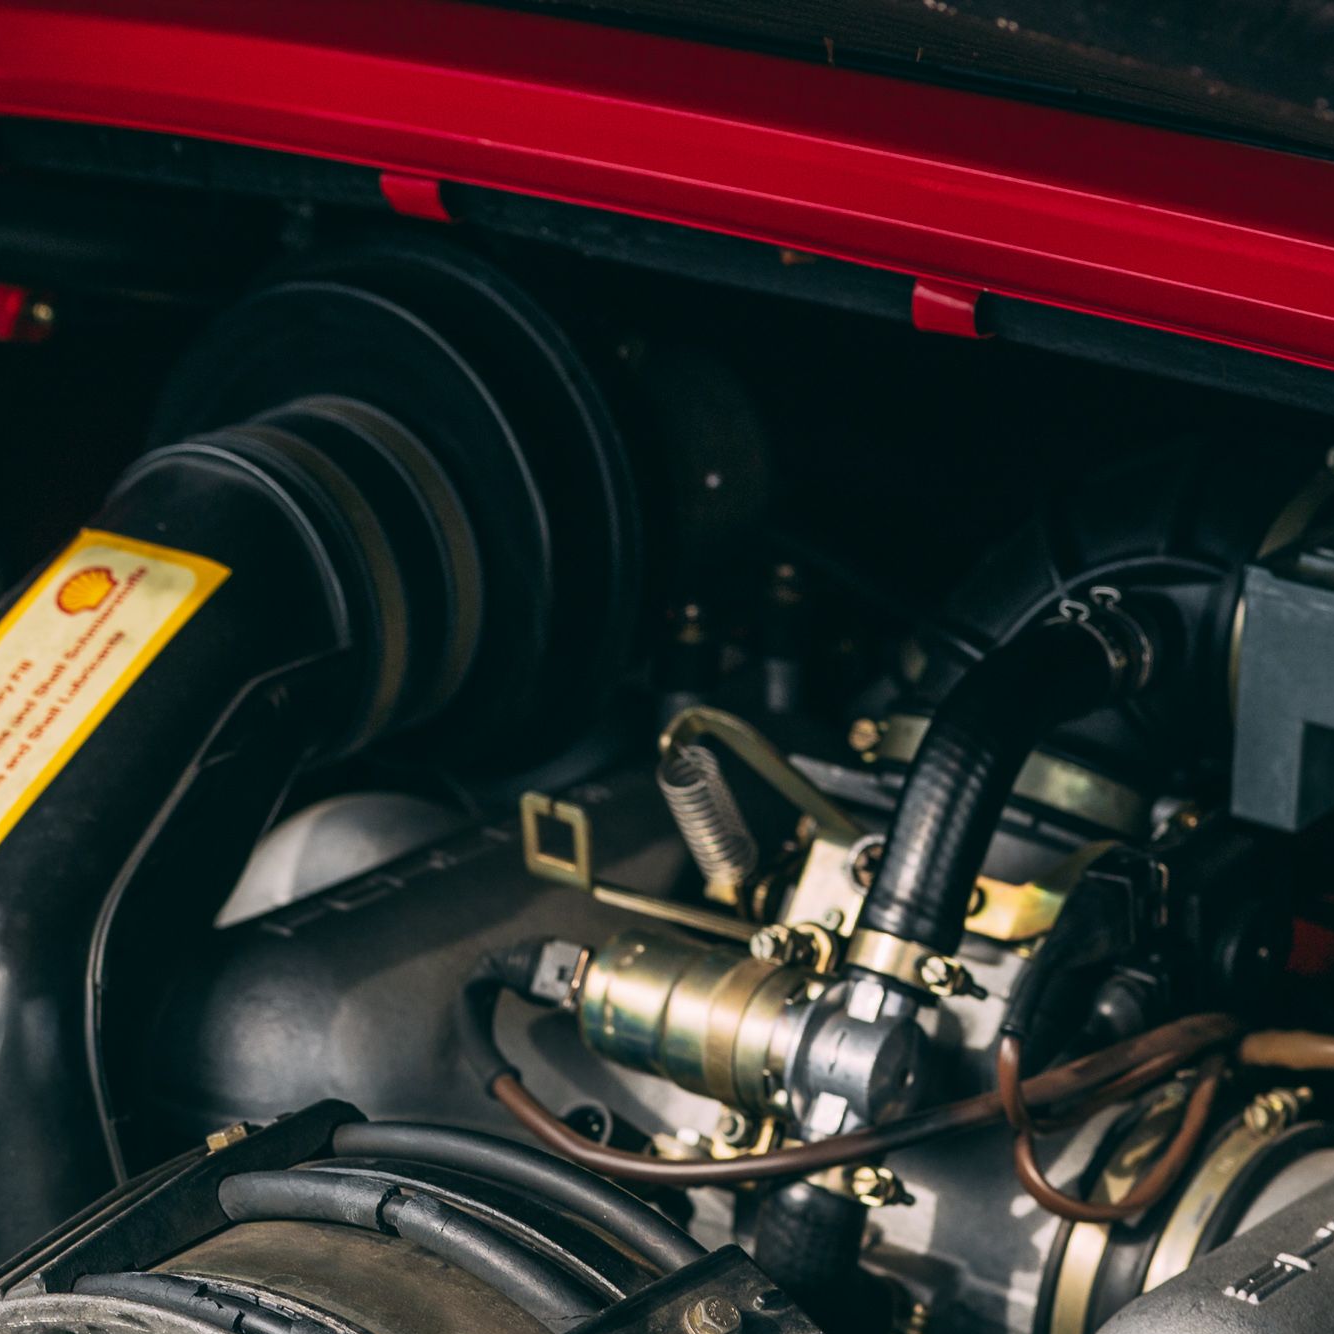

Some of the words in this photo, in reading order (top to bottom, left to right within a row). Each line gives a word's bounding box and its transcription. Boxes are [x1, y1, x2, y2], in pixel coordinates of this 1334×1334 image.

[8, 660, 33, 680] Fill
[32, 664, 66, 695] Shell
[2, 744, 29, 768] and
[27, 706, 61, 739] Shell
[58, 632, 125, 702] Lubricants
